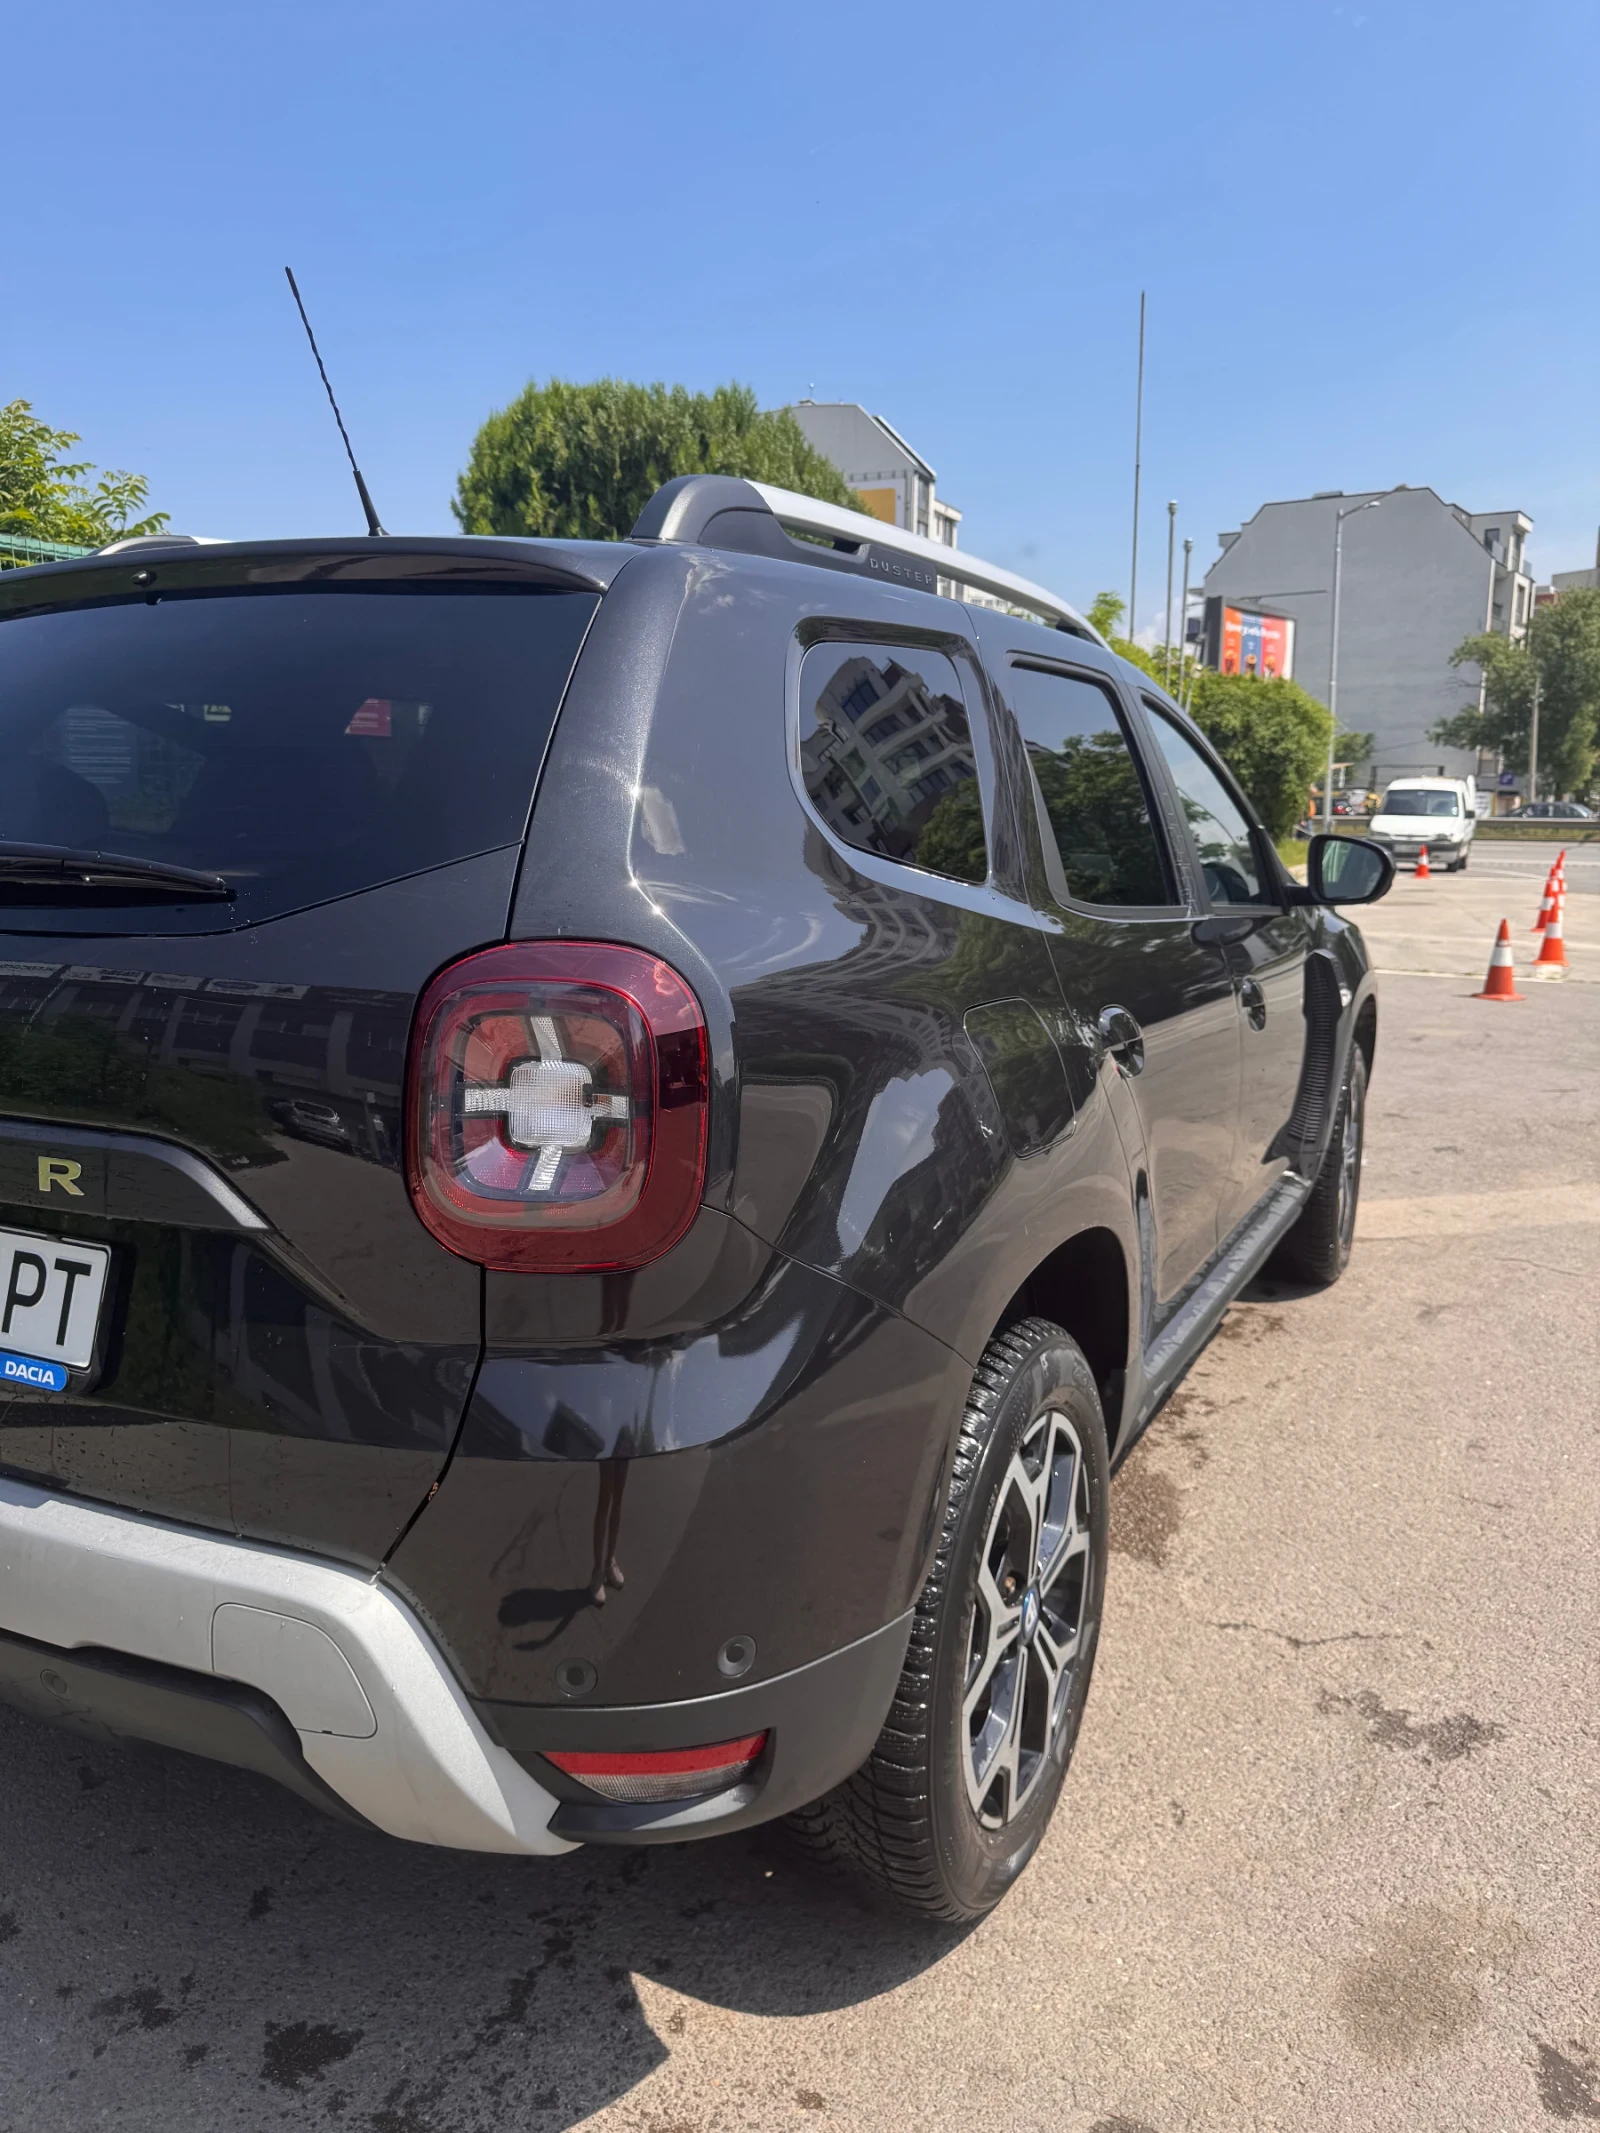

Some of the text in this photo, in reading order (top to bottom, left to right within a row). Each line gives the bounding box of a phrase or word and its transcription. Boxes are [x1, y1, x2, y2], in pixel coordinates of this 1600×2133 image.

[869, 558, 933, 585] DUSTER
[38, 1155, 85, 1196] R
[1, 1250, 92, 1346] PT
[5, 1360, 55, 1385] DACIA
